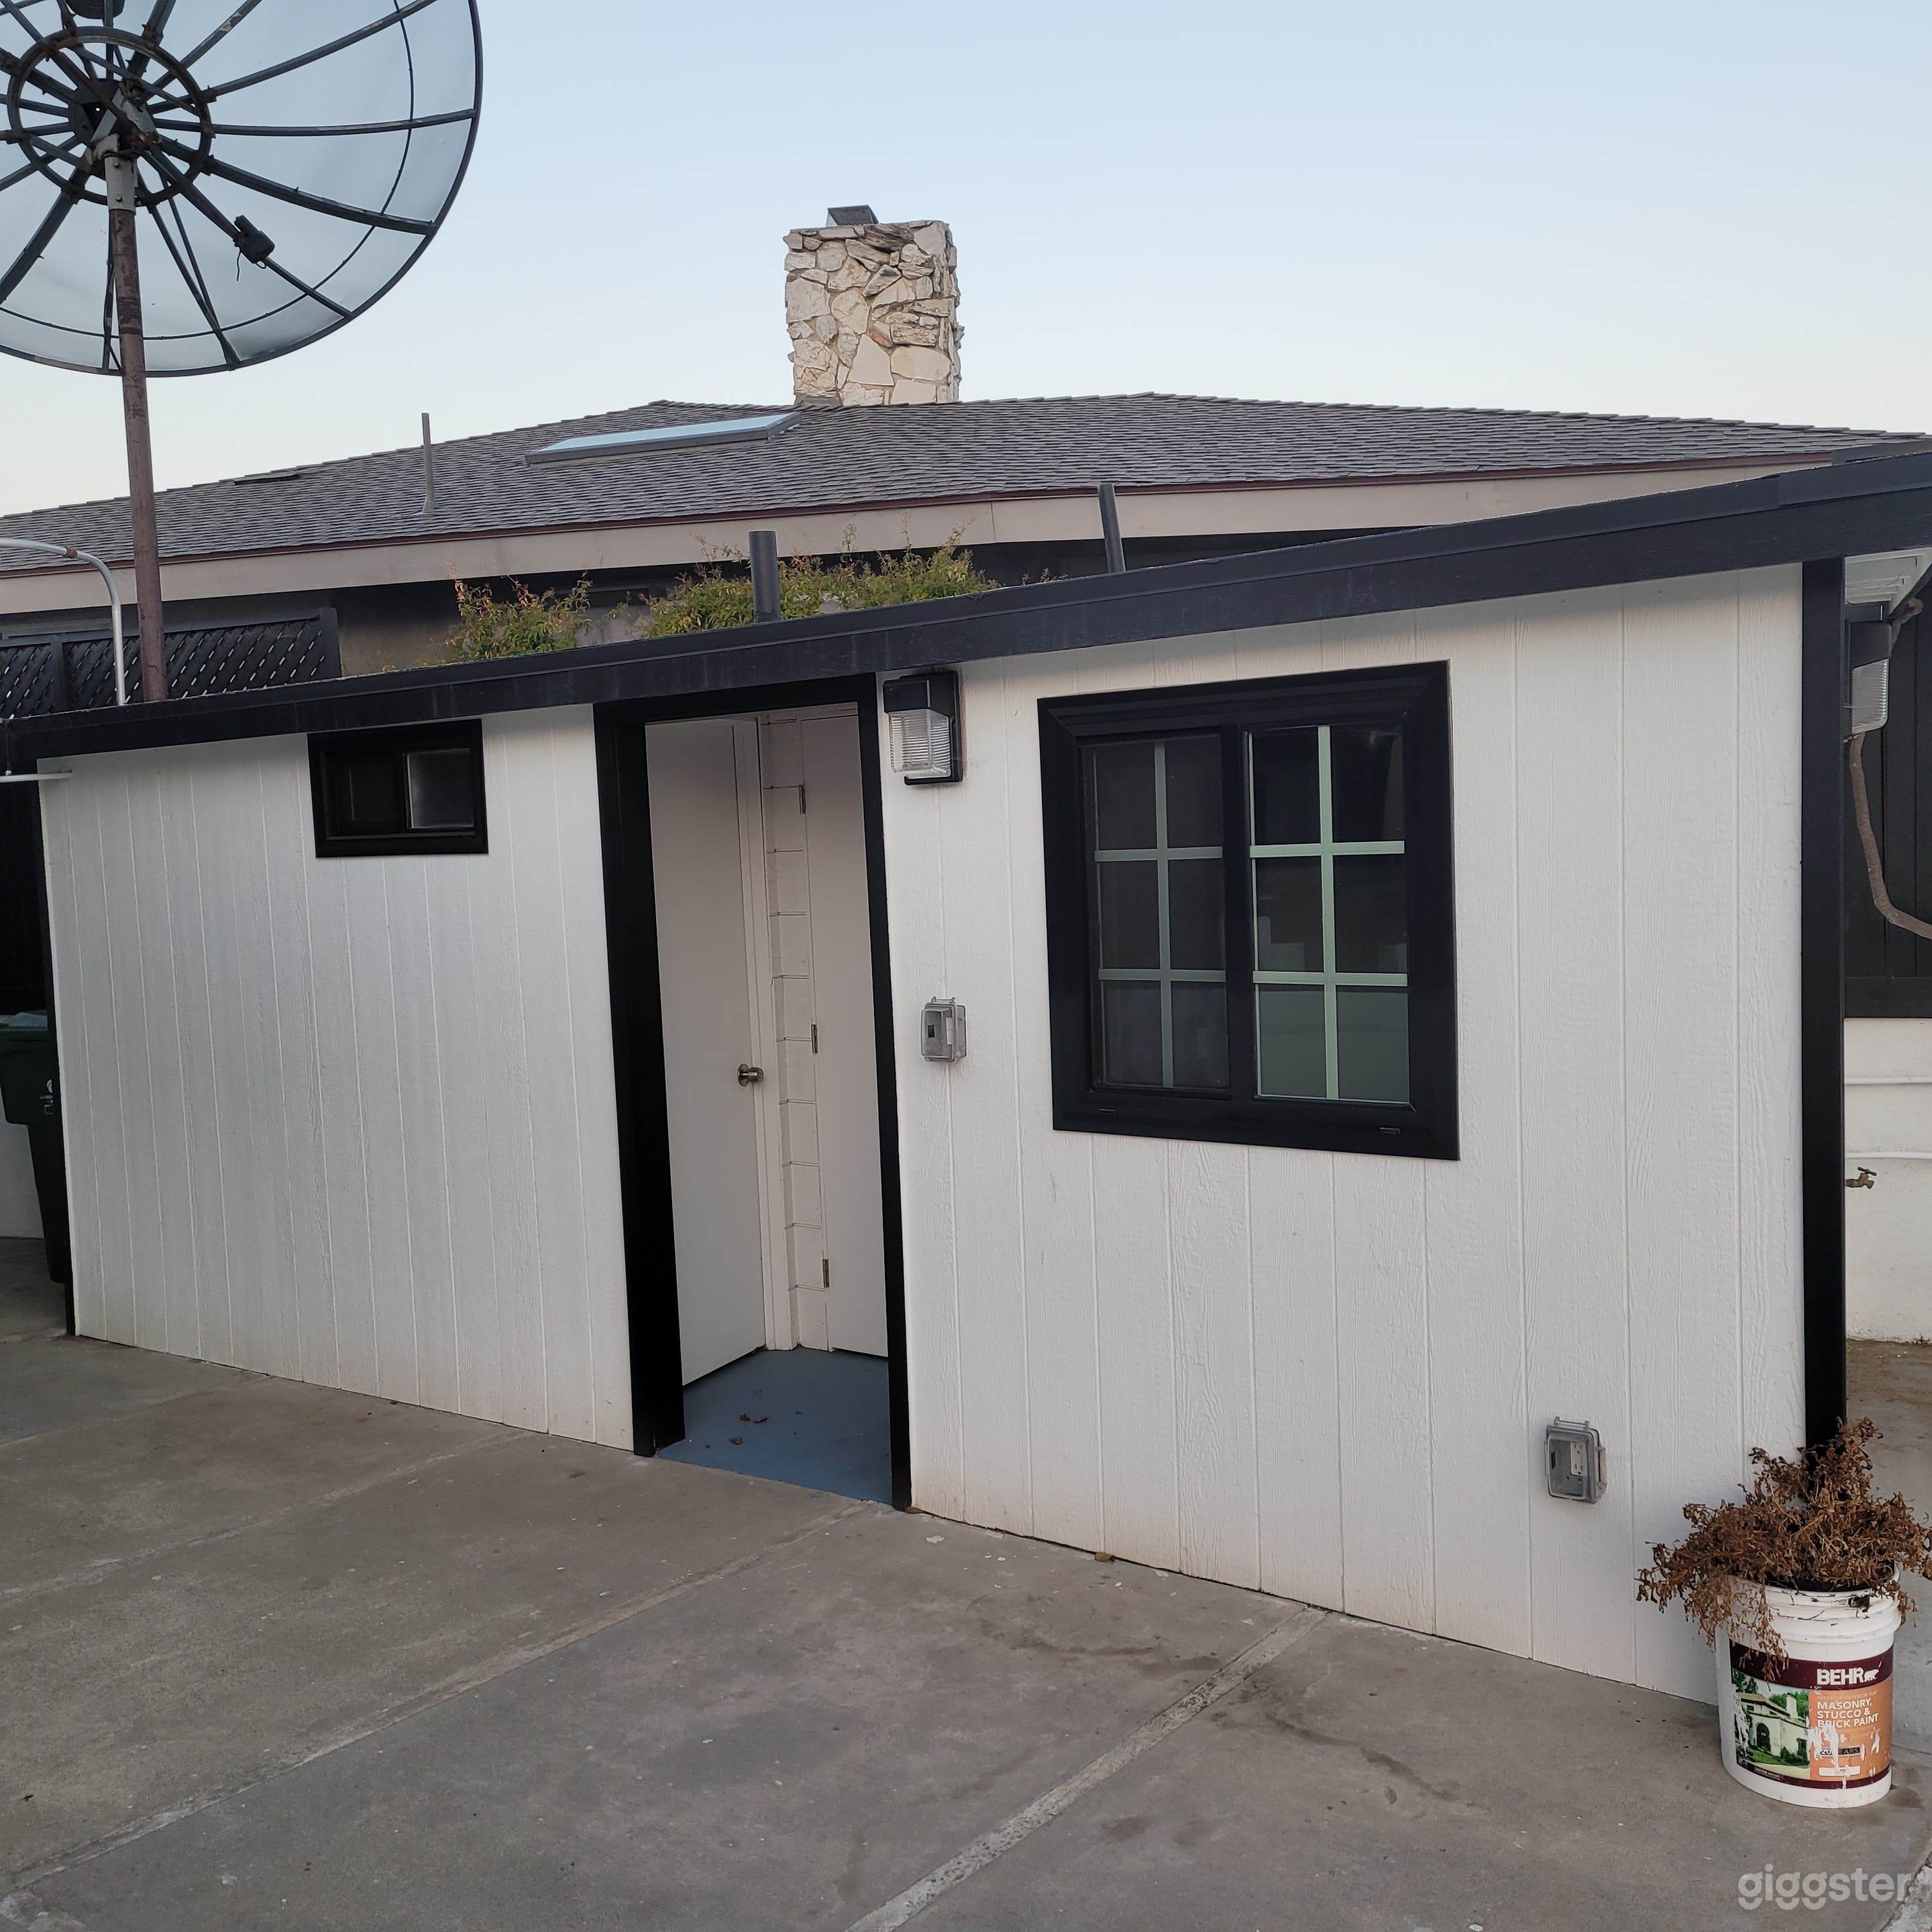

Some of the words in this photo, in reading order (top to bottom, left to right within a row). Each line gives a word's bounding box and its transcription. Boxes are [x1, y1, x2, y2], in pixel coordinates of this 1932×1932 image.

[1817, 1668, 1865, 1685] BEHR
[1817, 1698, 1872, 1710] MASONRY,
[1817, 1709, 1862, 1719] STUCCO
[1864, 1707, 1870, 1716] &
[1854, 1713, 1879, 1727] PAINT
